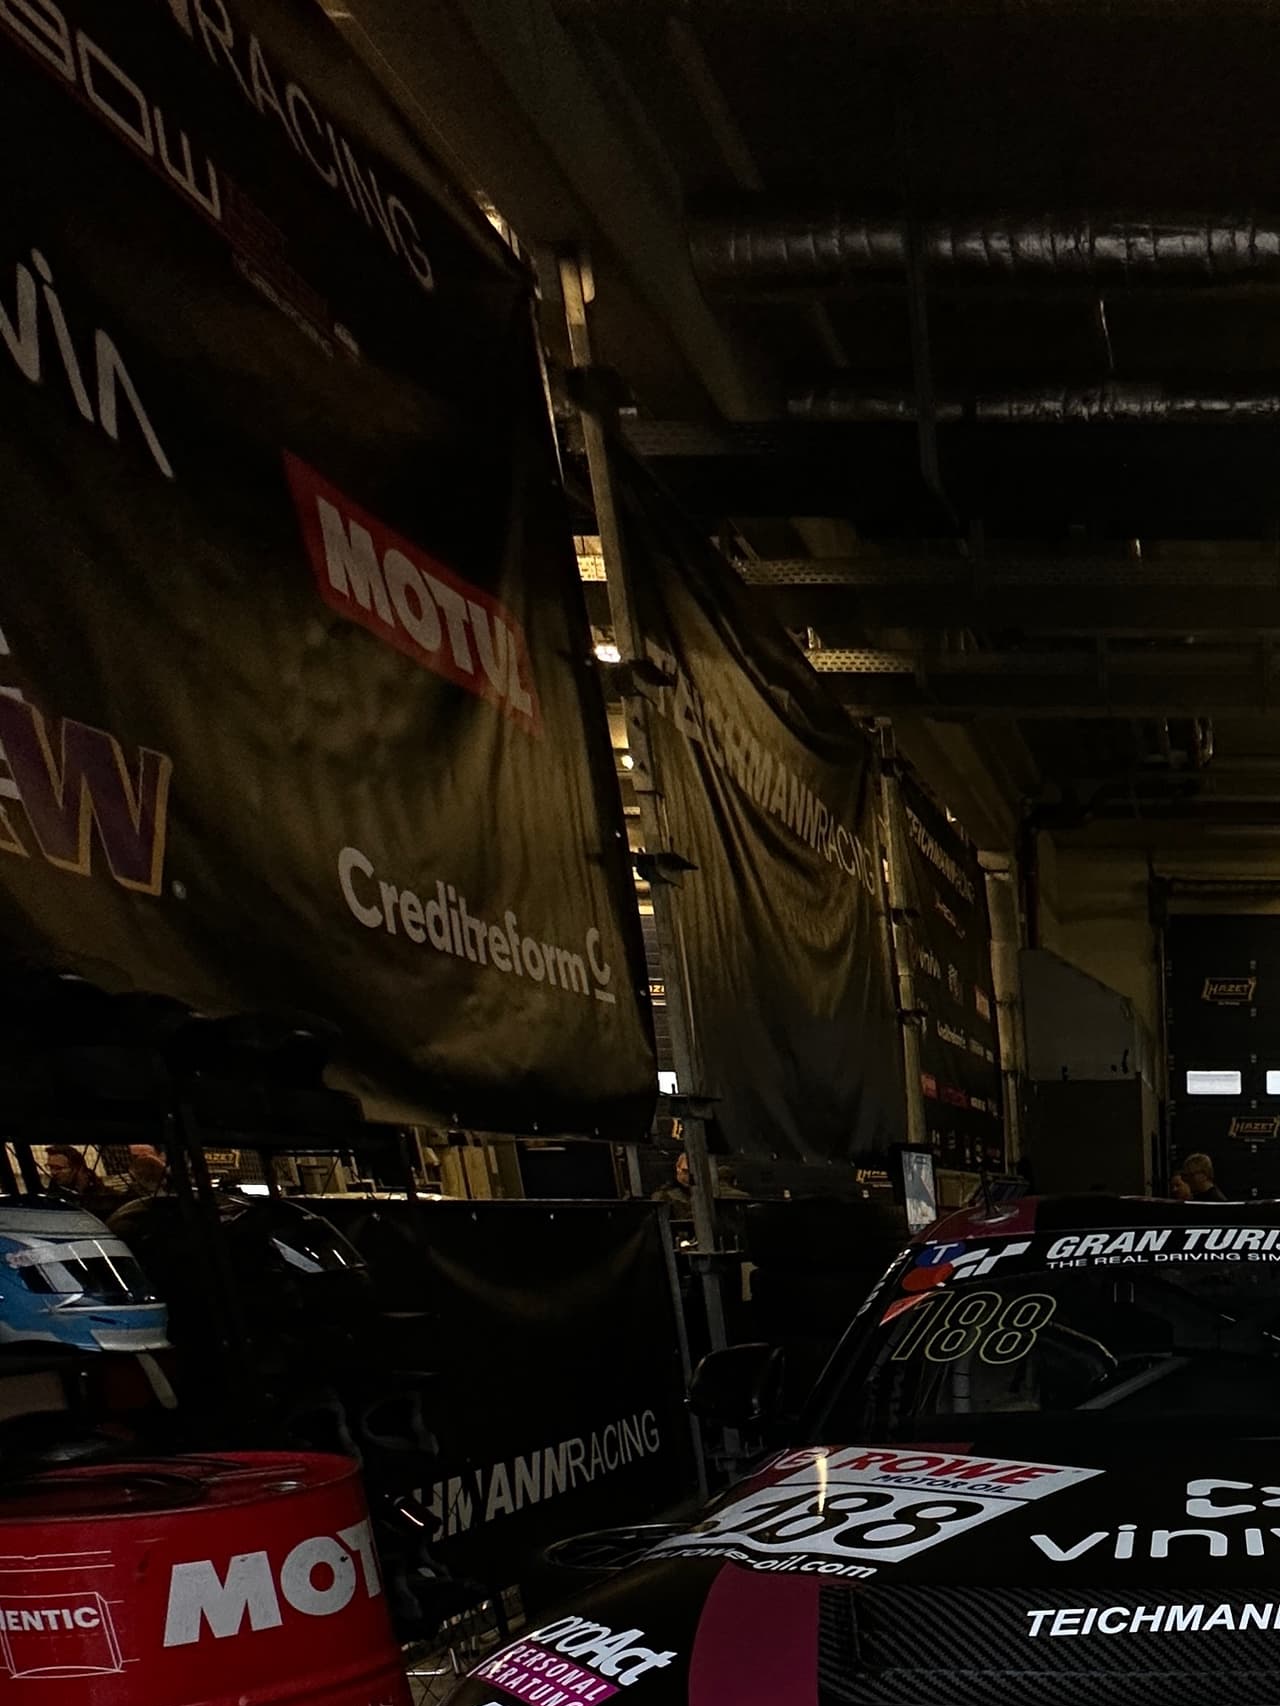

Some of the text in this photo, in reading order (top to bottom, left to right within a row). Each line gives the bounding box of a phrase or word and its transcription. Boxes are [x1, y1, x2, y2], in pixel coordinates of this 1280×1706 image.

[166, 0, 436, 293] RACING
[316, 495, 534, 718] MOTUL
[337, 846, 590, 996] Creditreform
[1045, 1229, 1173, 1260] GRAN
[1047, 1258, 1088, 1270] THE
[1094, 1254, 1150, 1266] REAL
[1157, 1251, 1242, 1263] DRIVING
[890, 1290, 1058, 1365] 188
[832, 1452, 1064, 1485] ROWE
[872, 1474, 1012, 1495] MOTOR OIL
[700, 1491, 984, 1549] 188
[495, 1615, 679, 1687] proAct
[508, 1643, 608, 1701] PERSONAL
